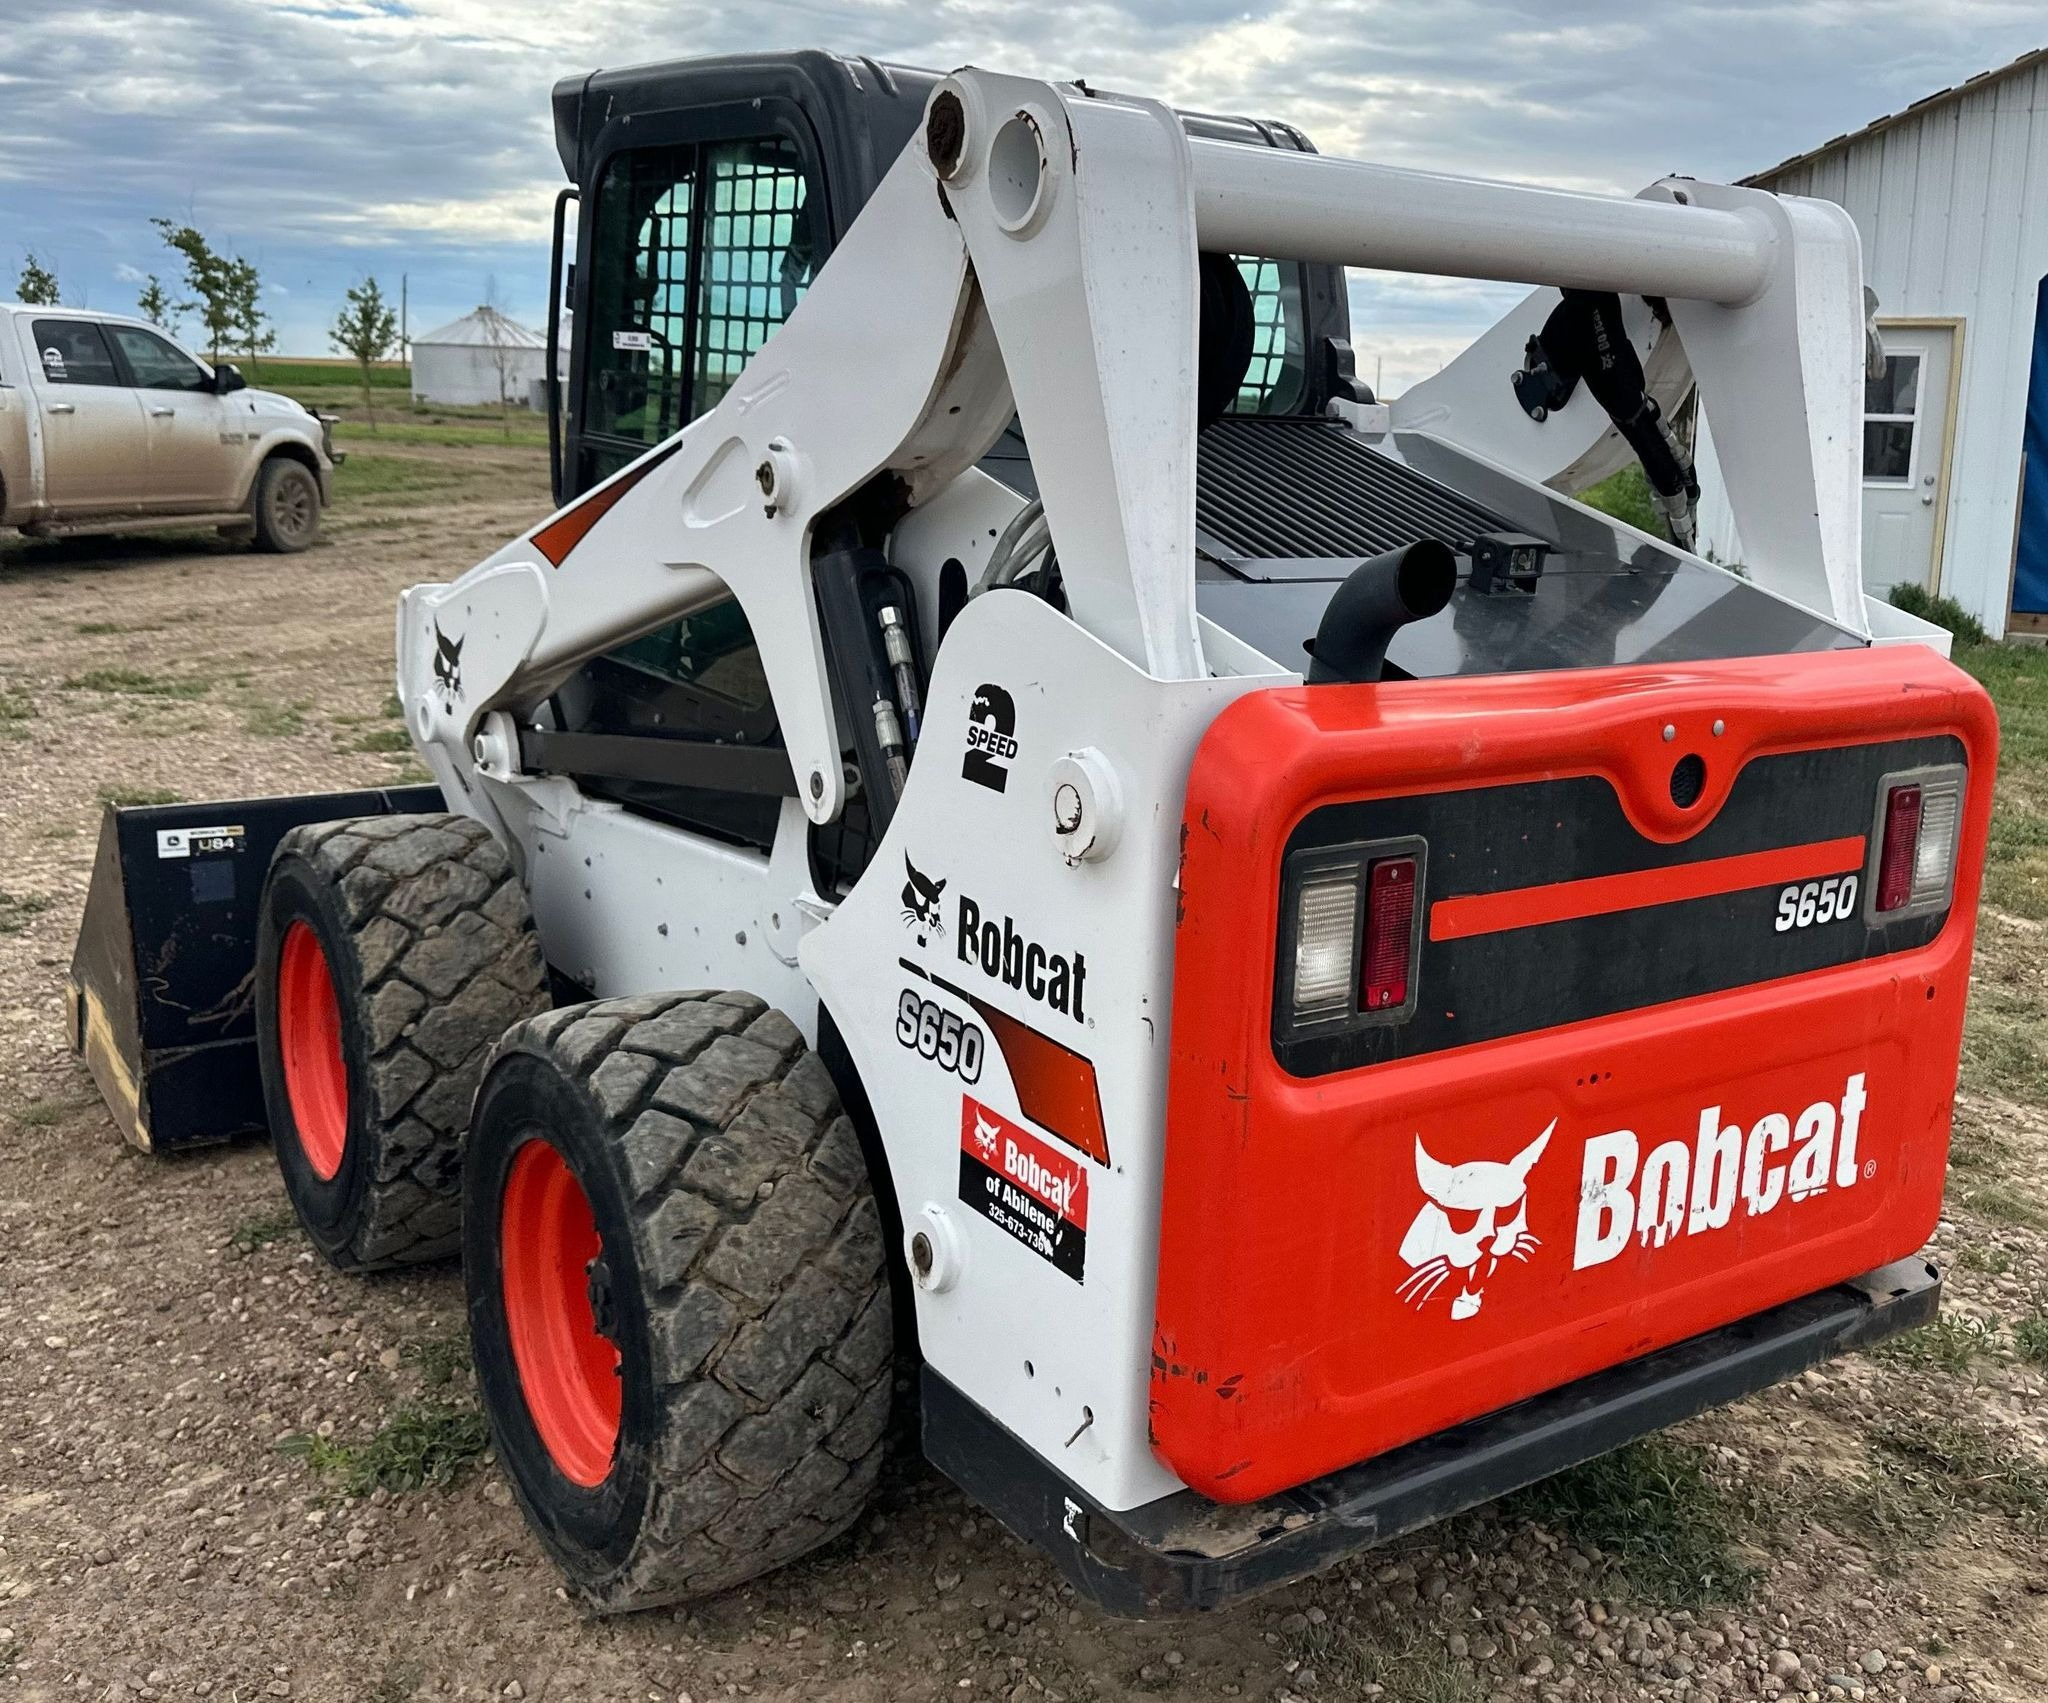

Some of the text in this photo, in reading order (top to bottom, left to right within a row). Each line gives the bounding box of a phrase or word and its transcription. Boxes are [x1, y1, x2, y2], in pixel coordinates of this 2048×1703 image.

[966, 725, 1019, 760] SPEED
[1774, 875, 1859, 932] S650
[957, 894, 1087, 1024] Bobcat
[895, 988, 985, 1086] S650
[1004, 1138, 1071, 1213] Bobcat
[1573, 1072, 1867, 1271] Bobcat
[985, 1176, 1055, 1235] of Abilene
[988, 1202, 1053, 1257] 325-673-736
